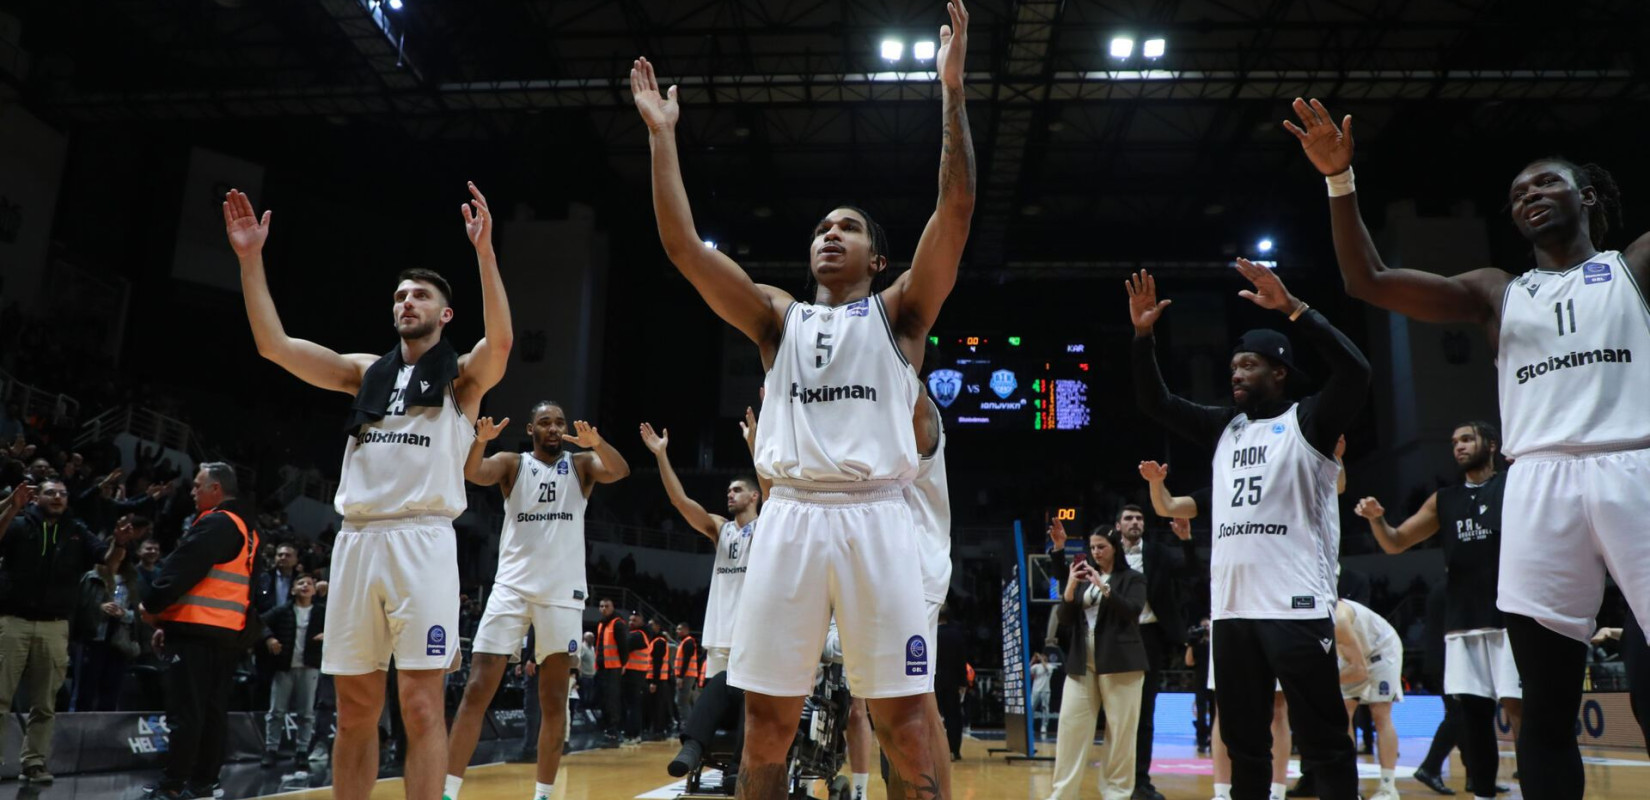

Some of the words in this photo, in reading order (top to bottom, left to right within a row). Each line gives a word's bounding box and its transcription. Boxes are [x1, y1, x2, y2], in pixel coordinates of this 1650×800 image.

[1555, 298, 1576, 336] 11
[815, 332, 833, 369] 5
[1516, 348, 1632, 385] Stoiximan
[1232, 445, 1268, 469] PAOK
[537, 481, 556, 503] 26
[1231, 475, 1263, 508] 25
[517, 511, 574, 523] Stoiximan
[1218, 521, 1288, 540] Stoiximan
